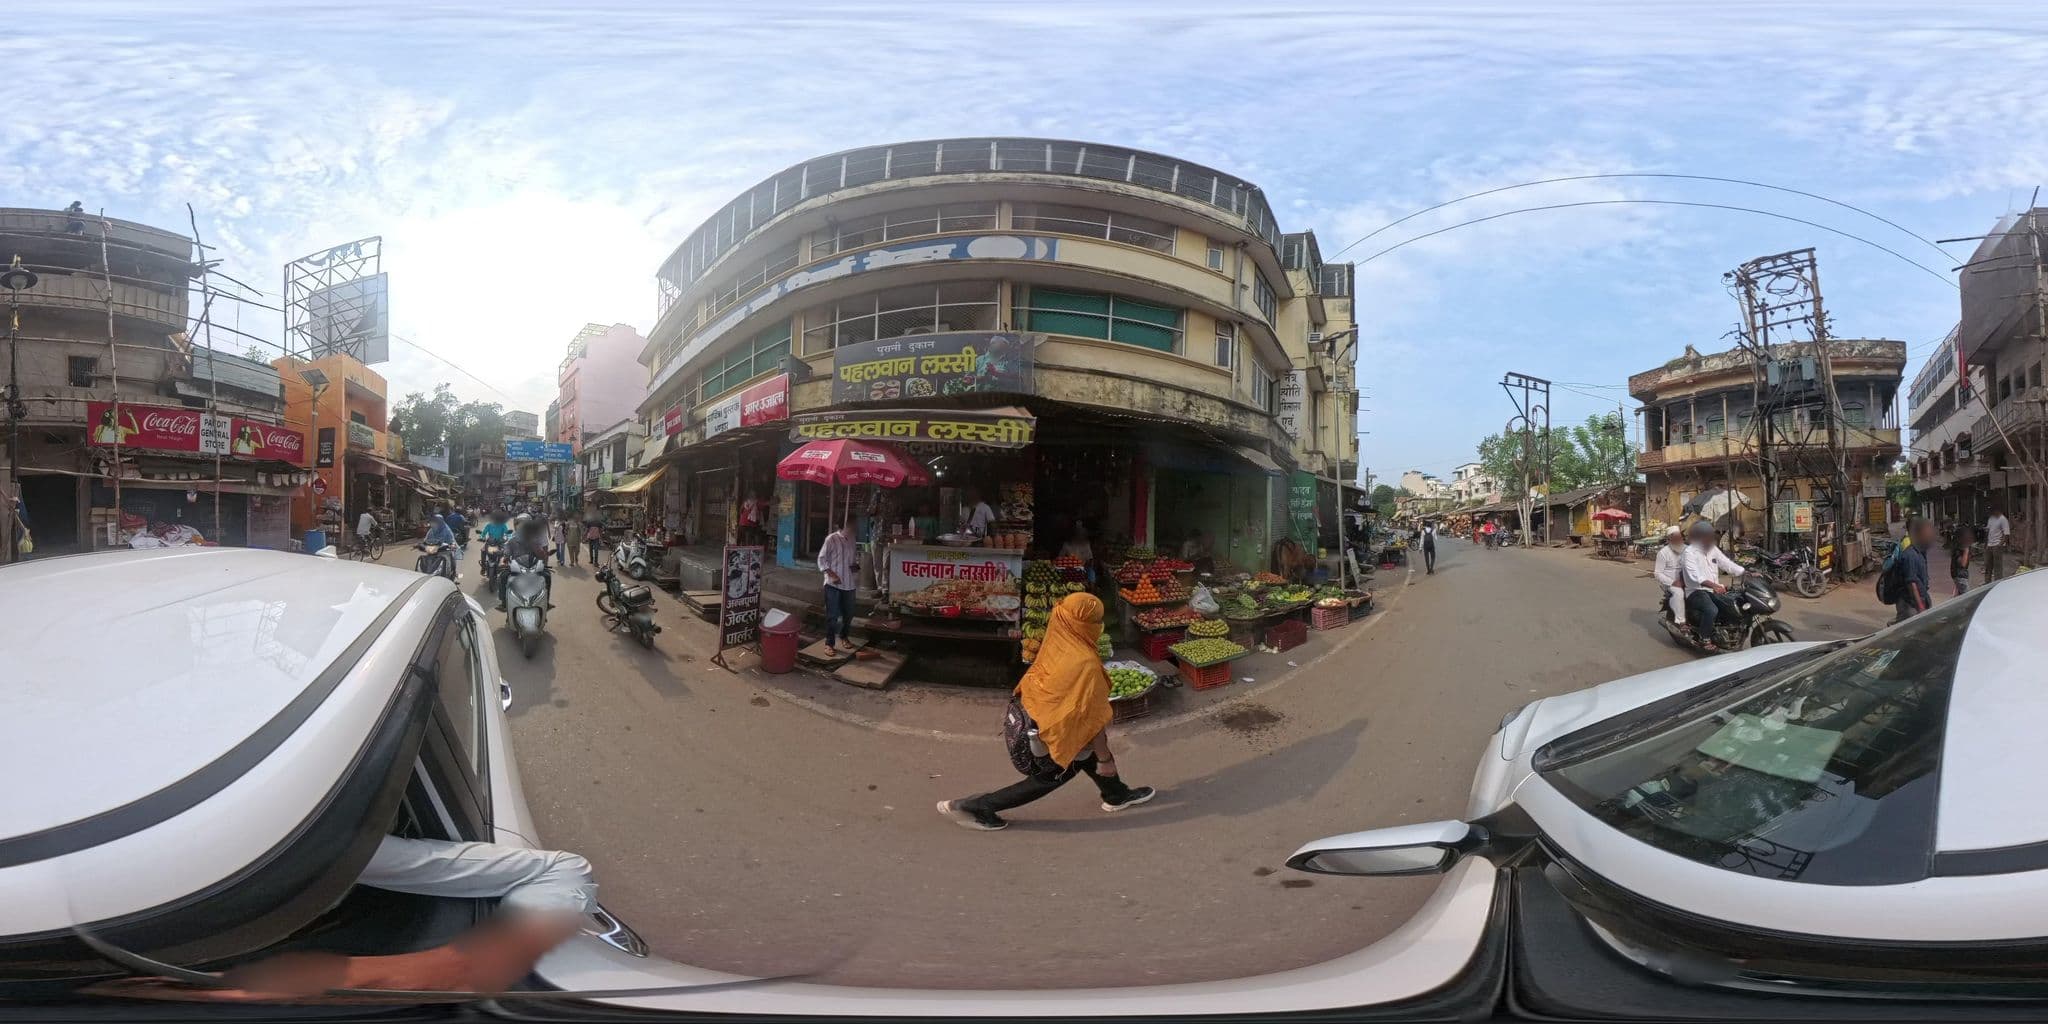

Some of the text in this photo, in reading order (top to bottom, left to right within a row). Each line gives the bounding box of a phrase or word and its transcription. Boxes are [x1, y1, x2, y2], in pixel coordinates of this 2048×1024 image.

[908, 341, 935, 353] दुकान
[840, 345, 977, 383] पहलवान लस्सी
[798, 420, 920, 439] पहलवान
[902, 561, 1003, 582] पहलवान लस्सी
[724, 609, 758, 627] जेन्ट्स
[726, 627, 755, 645] पार्लर
